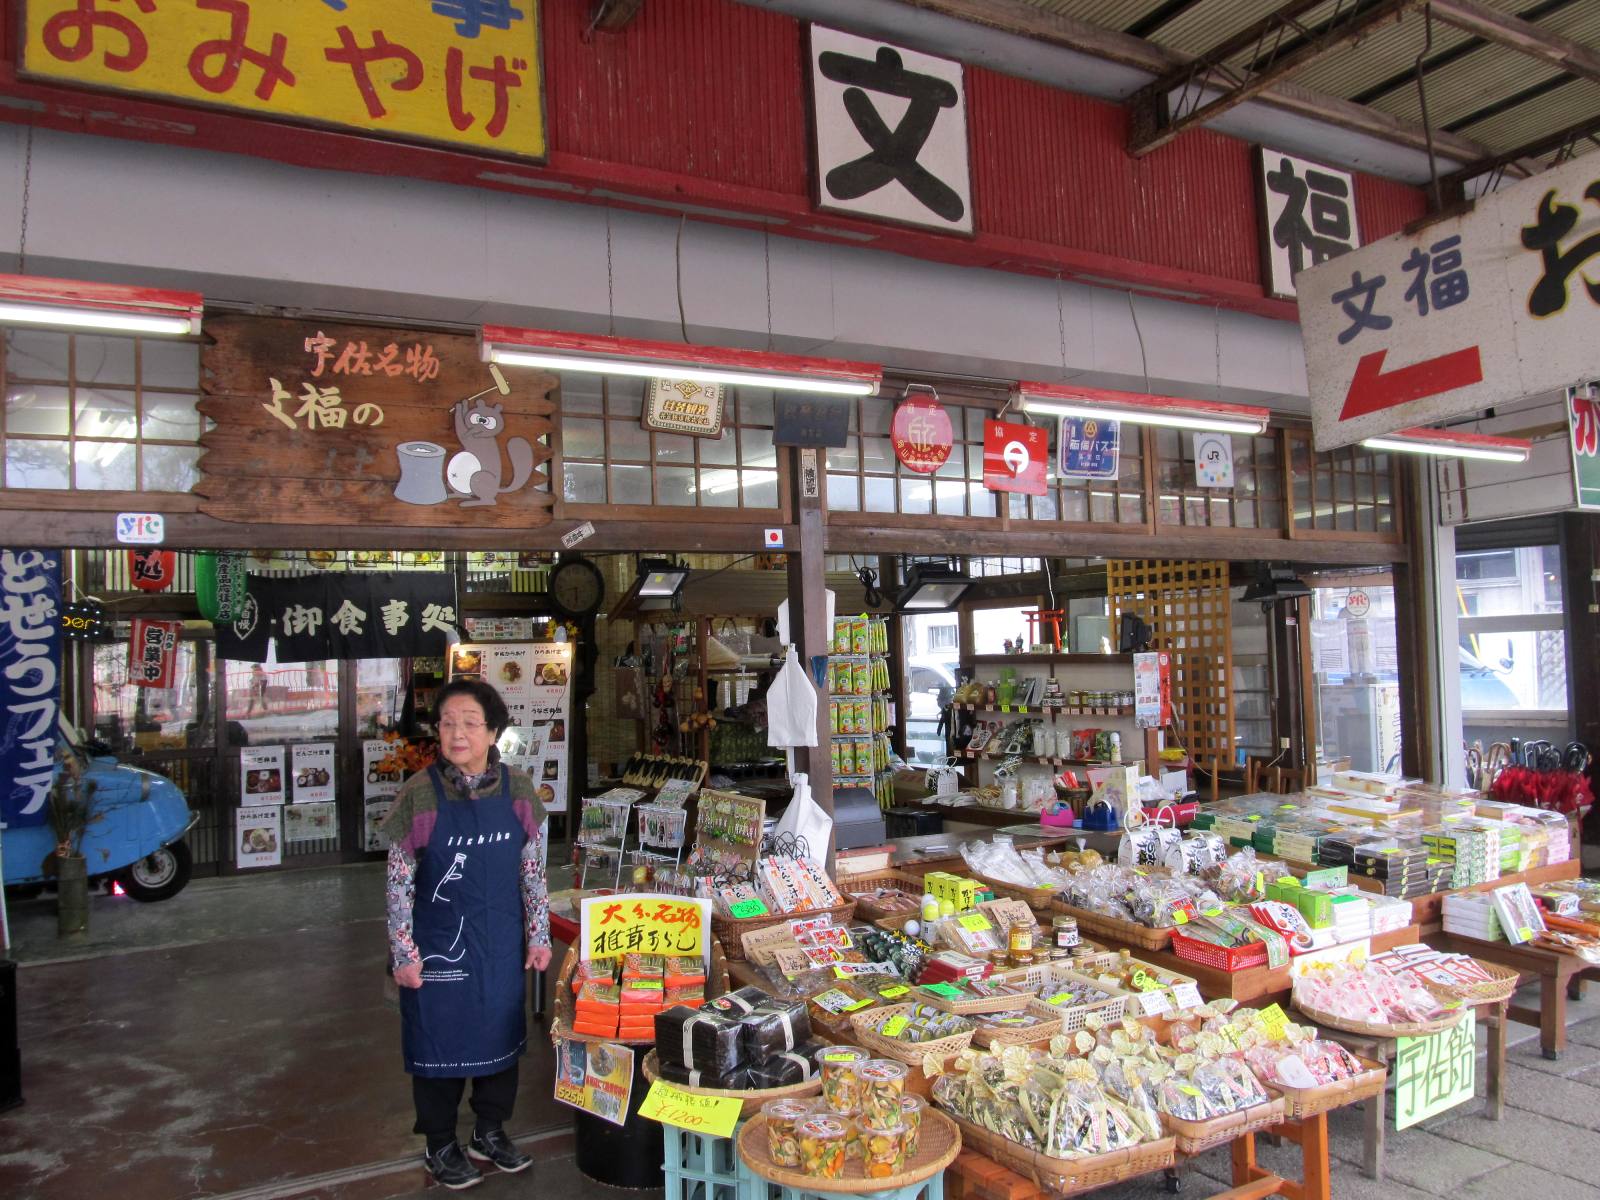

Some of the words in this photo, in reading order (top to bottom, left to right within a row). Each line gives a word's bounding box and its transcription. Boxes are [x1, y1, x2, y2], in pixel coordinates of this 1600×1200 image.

[818, 46, 965, 222] 文
[1331, 234, 1470, 346] 文福
[304, 330, 440, 383] 宇佐名物
[282, 599, 456, 637] 御食事処
[143, 627, 164, 681] 営業中
[448, 831, 511, 847] iichiko
